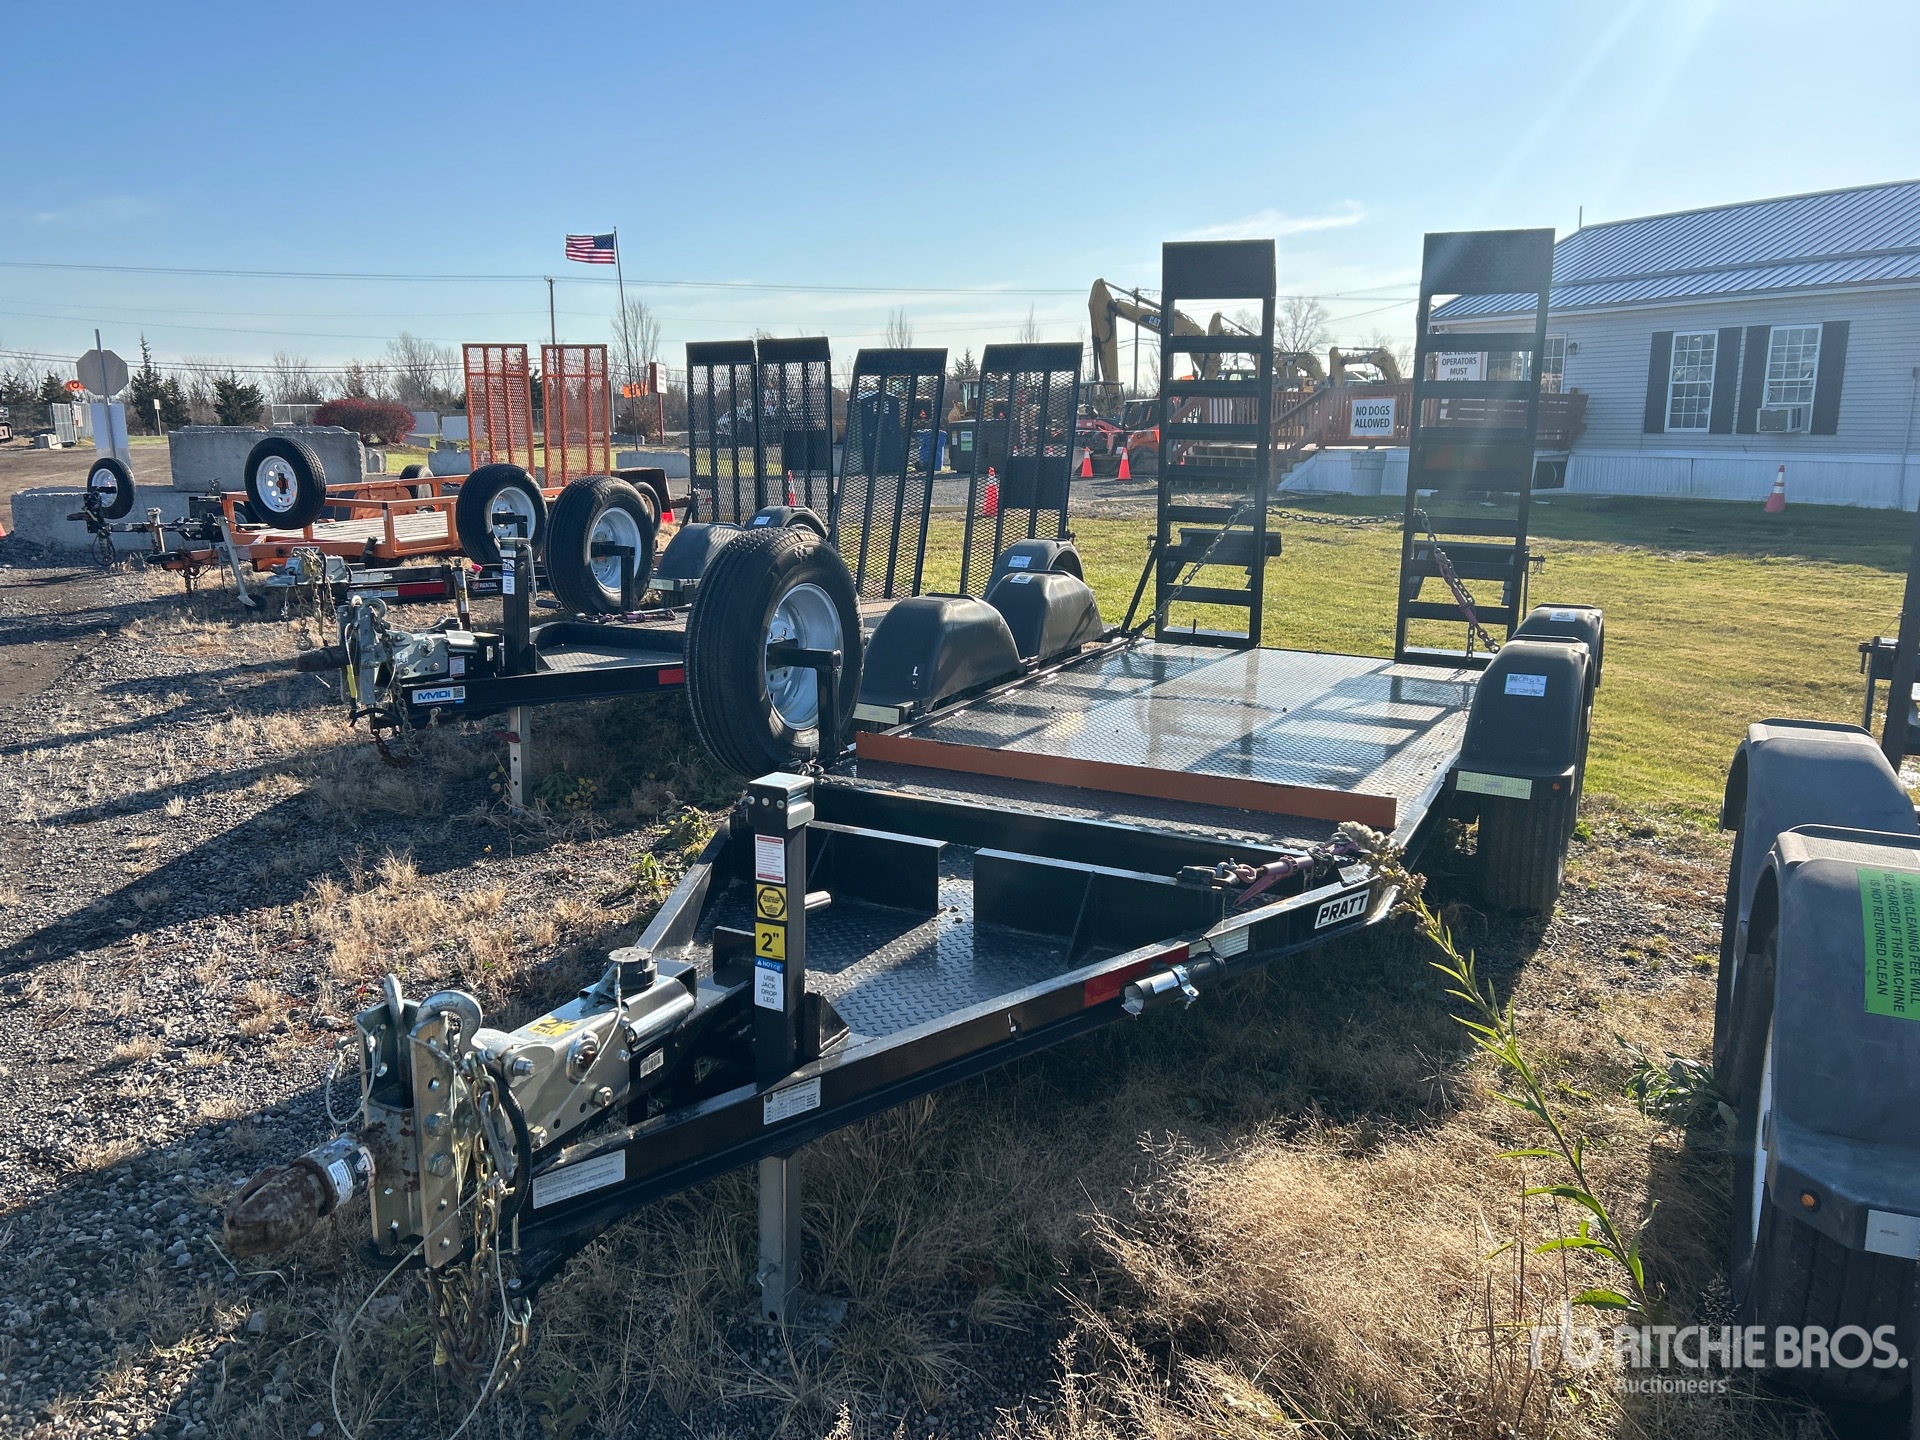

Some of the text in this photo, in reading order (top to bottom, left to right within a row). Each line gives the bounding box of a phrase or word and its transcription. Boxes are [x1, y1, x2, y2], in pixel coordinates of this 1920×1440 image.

[1441, 357, 1477, 366] OPERATORS
[1450, 367, 1467, 375] MUST
[1355, 405, 1390, 416] NO DOGS
[1354, 418, 1390, 428] ALLOWED
[1902, 887, 1914, 905] $200
[1318, 893, 1368, 924] PRATT
[1904, 906, 1920, 952] CLEANING
[1870, 879, 1888, 996] IS NOT RETURNED CLEAN
[1884, 873, 1905, 1013] BE CHARGED IF THIS MACHINE
[1909, 955, 1920, 975] FEE
[763, 974, 775, 982] USE
[761, 982, 776, 990] JACK
[1910, 978, 1920, 1005] WILL
[761, 988, 777, 997] DROP
[763, 996, 775, 1004] LEG
